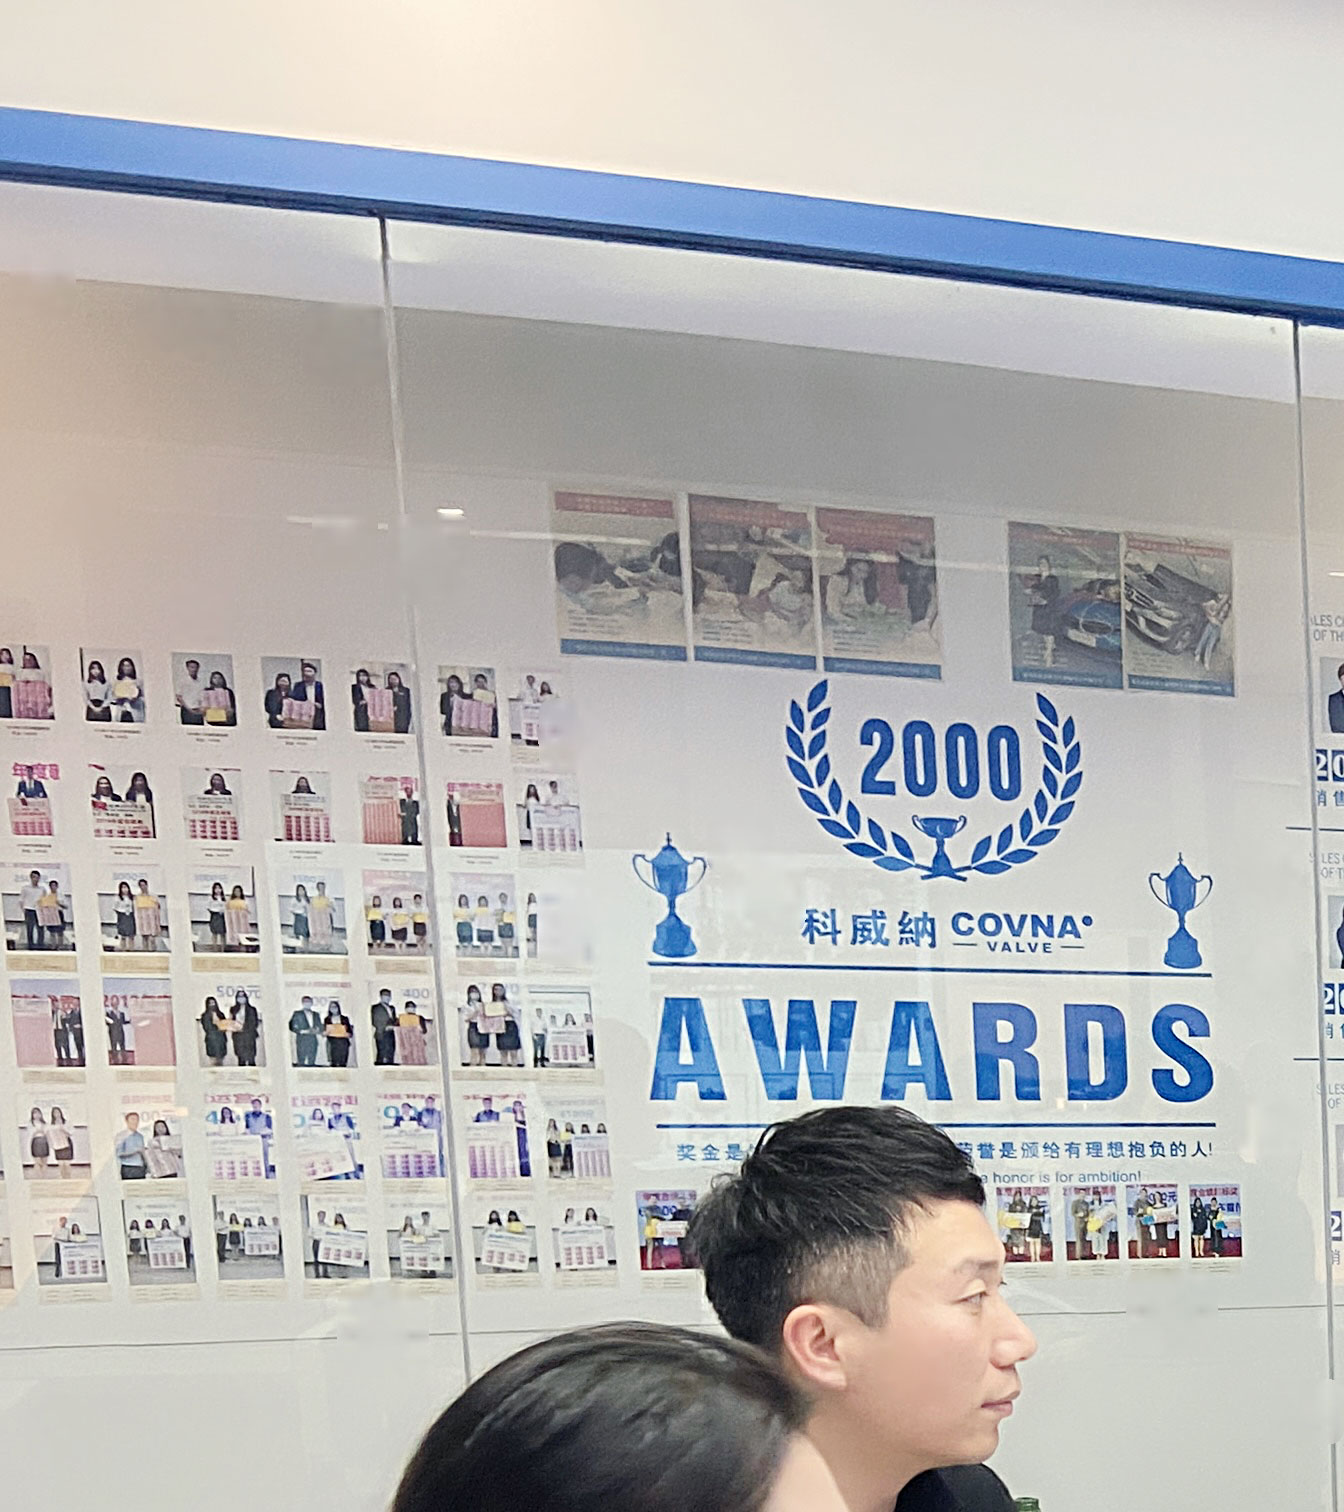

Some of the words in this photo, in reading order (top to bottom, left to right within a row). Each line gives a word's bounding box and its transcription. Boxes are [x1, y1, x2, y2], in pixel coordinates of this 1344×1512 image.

[860, 717, 1021, 802] 2000
[951, 911, 1082, 940] COVNA
[987, 942, 1053, 954] VALVE
[650, 996, 1216, 1103] AWARDS
[992, 1171, 1034, 1184] honor
[1039, 1171, 1050, 1183] is
[1055, 1170, 1073, 1183] for
[1078, 1169, 1142, 1183] ambition!
